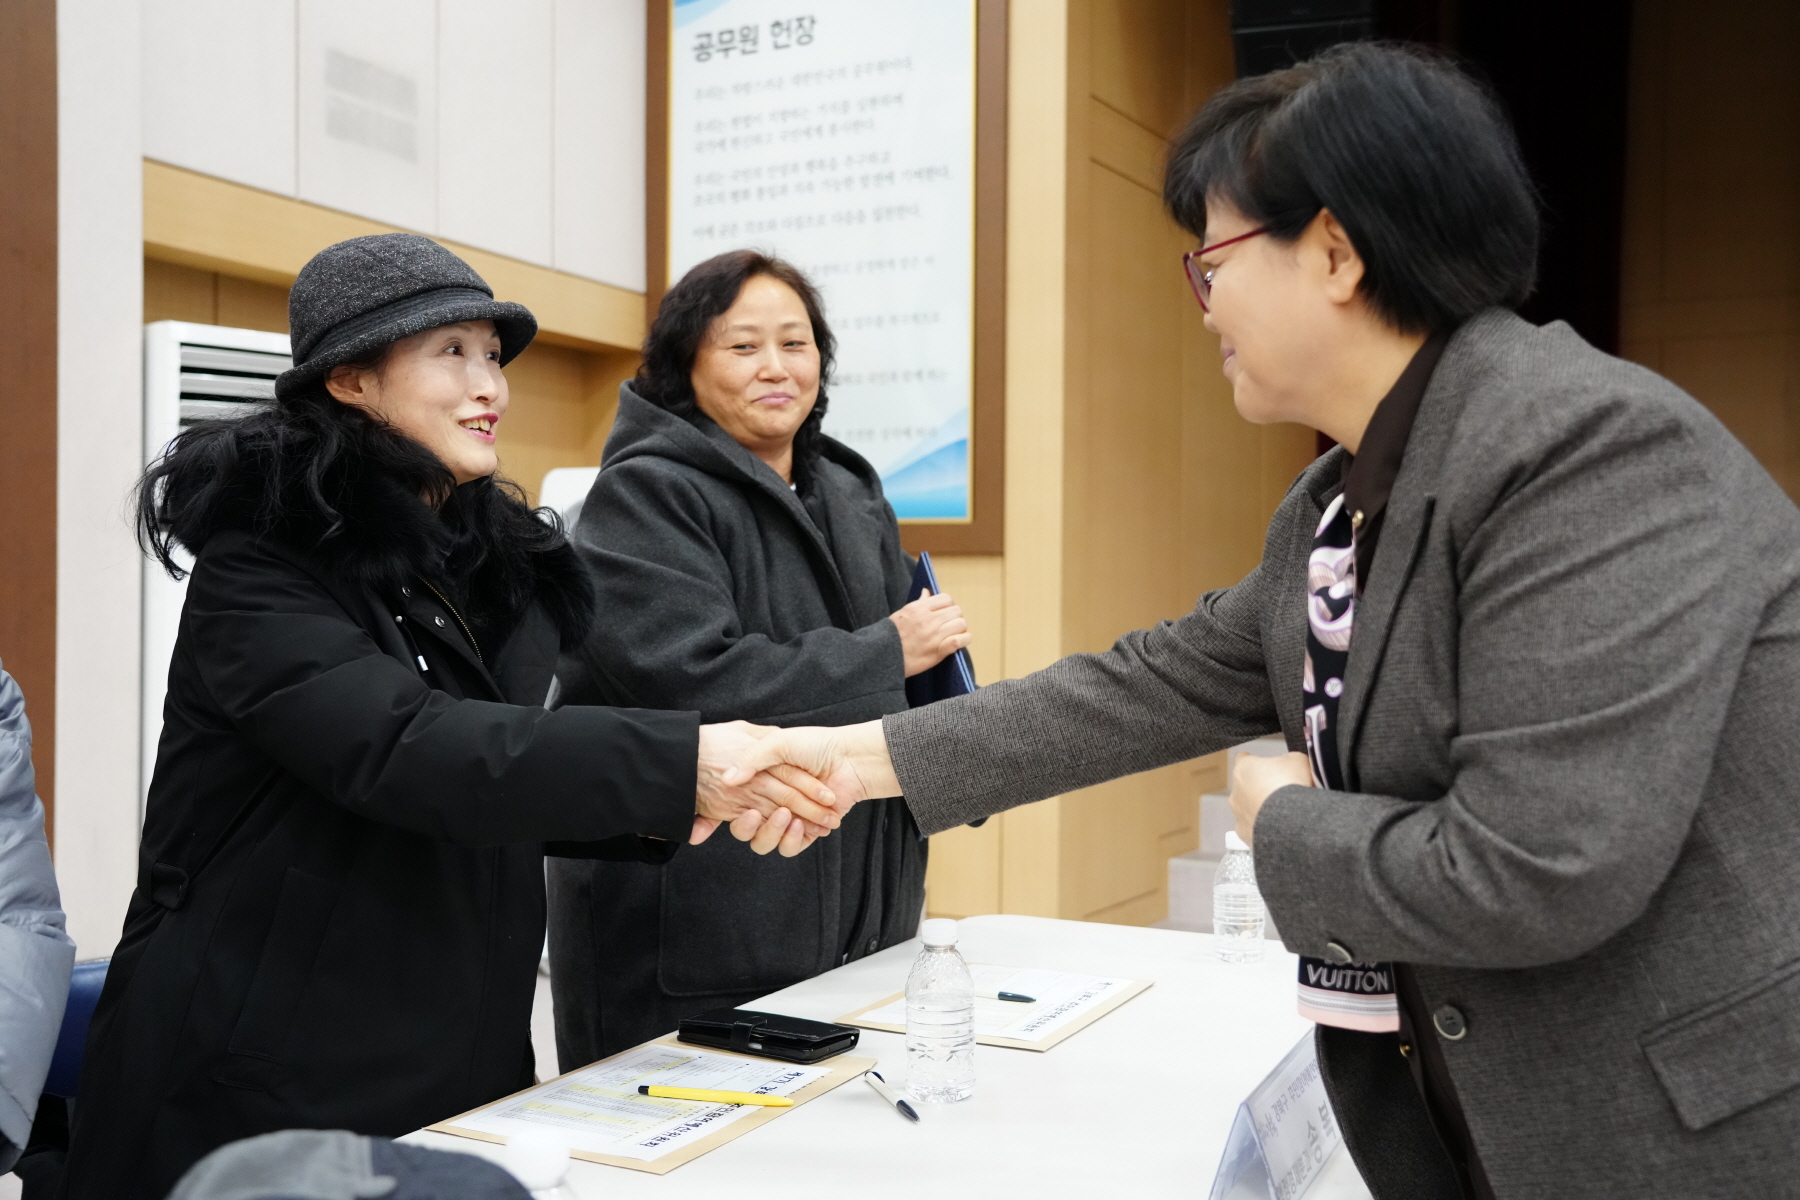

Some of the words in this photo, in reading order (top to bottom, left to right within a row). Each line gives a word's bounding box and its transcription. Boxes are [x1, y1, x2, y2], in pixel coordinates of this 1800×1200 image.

[691, 24, 760, 63] 공무원
[769, 14, 817, 50] 헌장
[1306, 963, 1390, 992] VUITTON
[1270, 1092, 1290, 1123] 강북구
